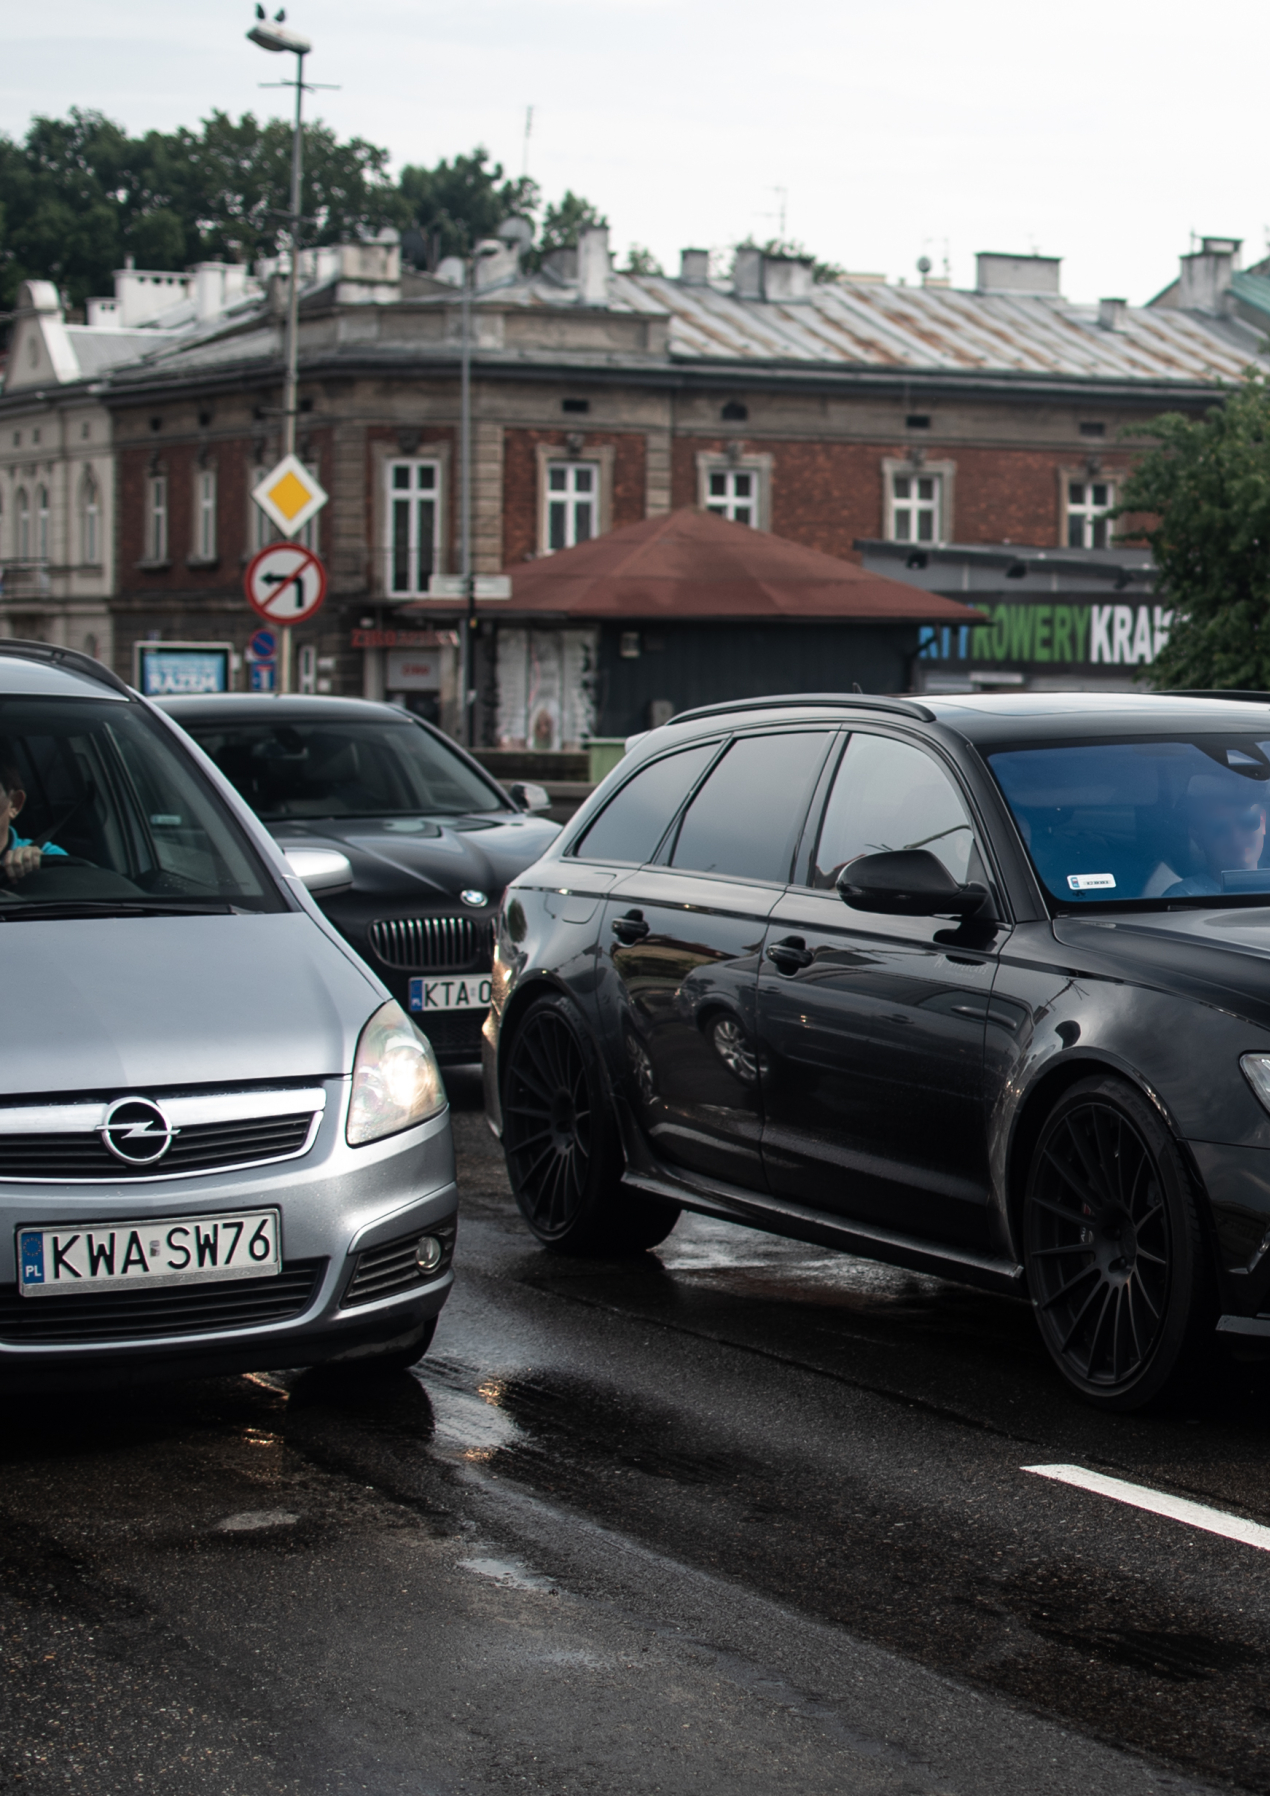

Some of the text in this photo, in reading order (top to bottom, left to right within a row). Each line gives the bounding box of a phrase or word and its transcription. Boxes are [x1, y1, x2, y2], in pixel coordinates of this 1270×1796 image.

[424, 981, 470, 1007] KTA
[53, 1218, 271, 1279] KWA SW76
[25, 1264, 42, 1278] PL
